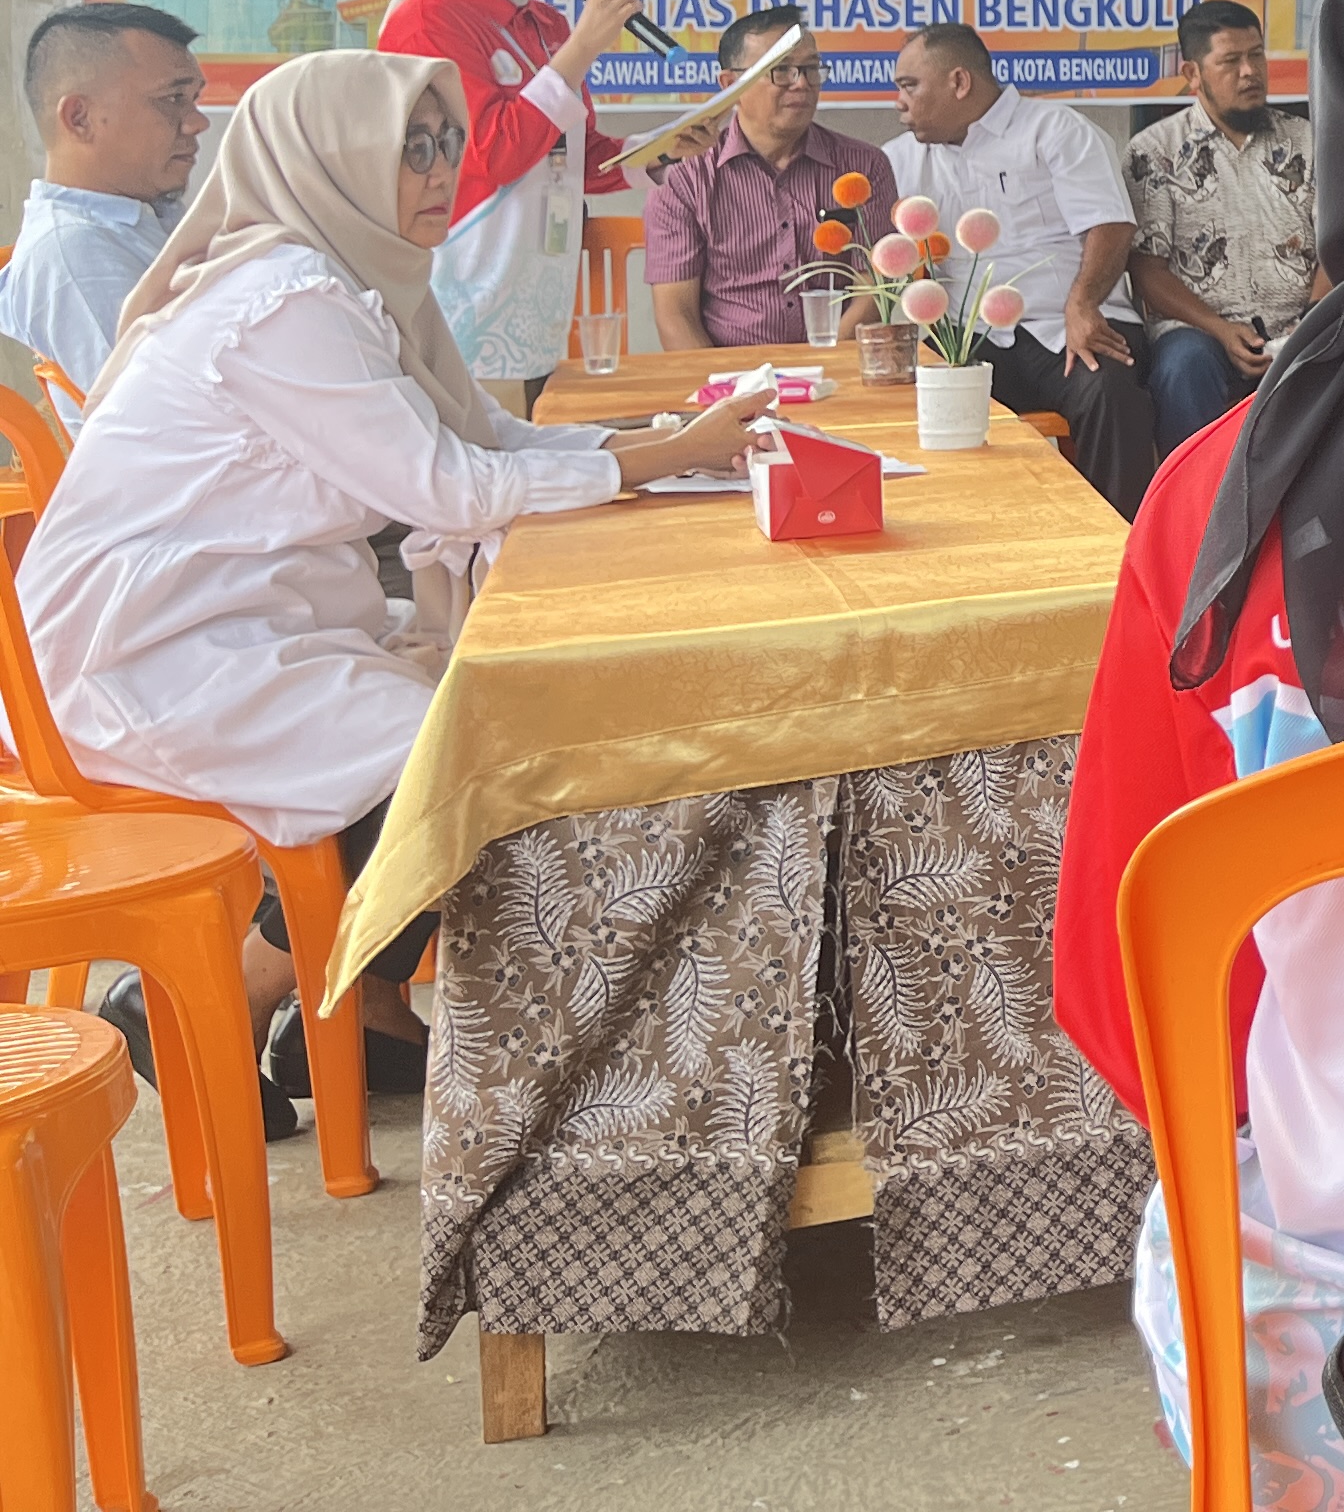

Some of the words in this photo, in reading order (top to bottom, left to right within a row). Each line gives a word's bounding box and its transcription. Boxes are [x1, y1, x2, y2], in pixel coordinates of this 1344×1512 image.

[591, 60, 658, 86] SAWAH
[664, 59, 721, 85] LEBAR
[828, 58, 897, 84] AMATAN
[1013, 58, 1056, 83] KOTA
[1061, 57, 1149, 83] BENGKULU
